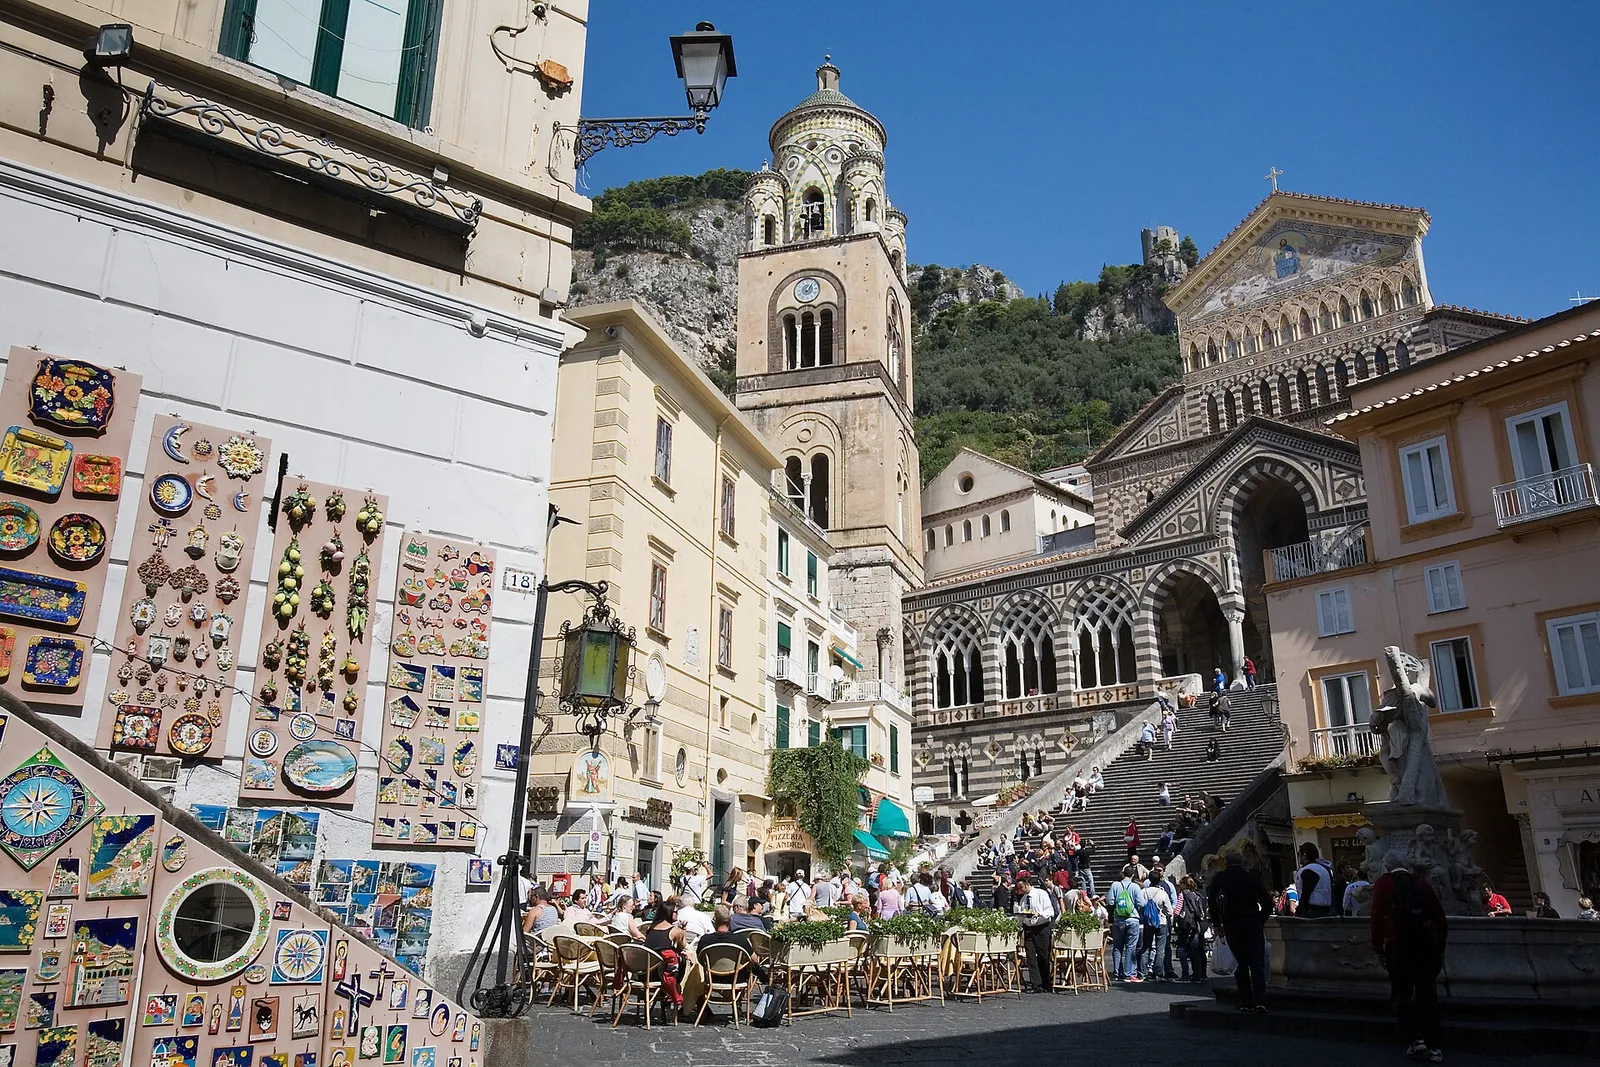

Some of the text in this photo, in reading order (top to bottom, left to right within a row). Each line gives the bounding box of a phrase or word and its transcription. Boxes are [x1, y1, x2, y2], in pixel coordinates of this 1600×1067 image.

[511, 574, 530, 588] 18
[771, 833, 804, 842] PIZZERIA
[776, 841, 807, 850] ANDREA
